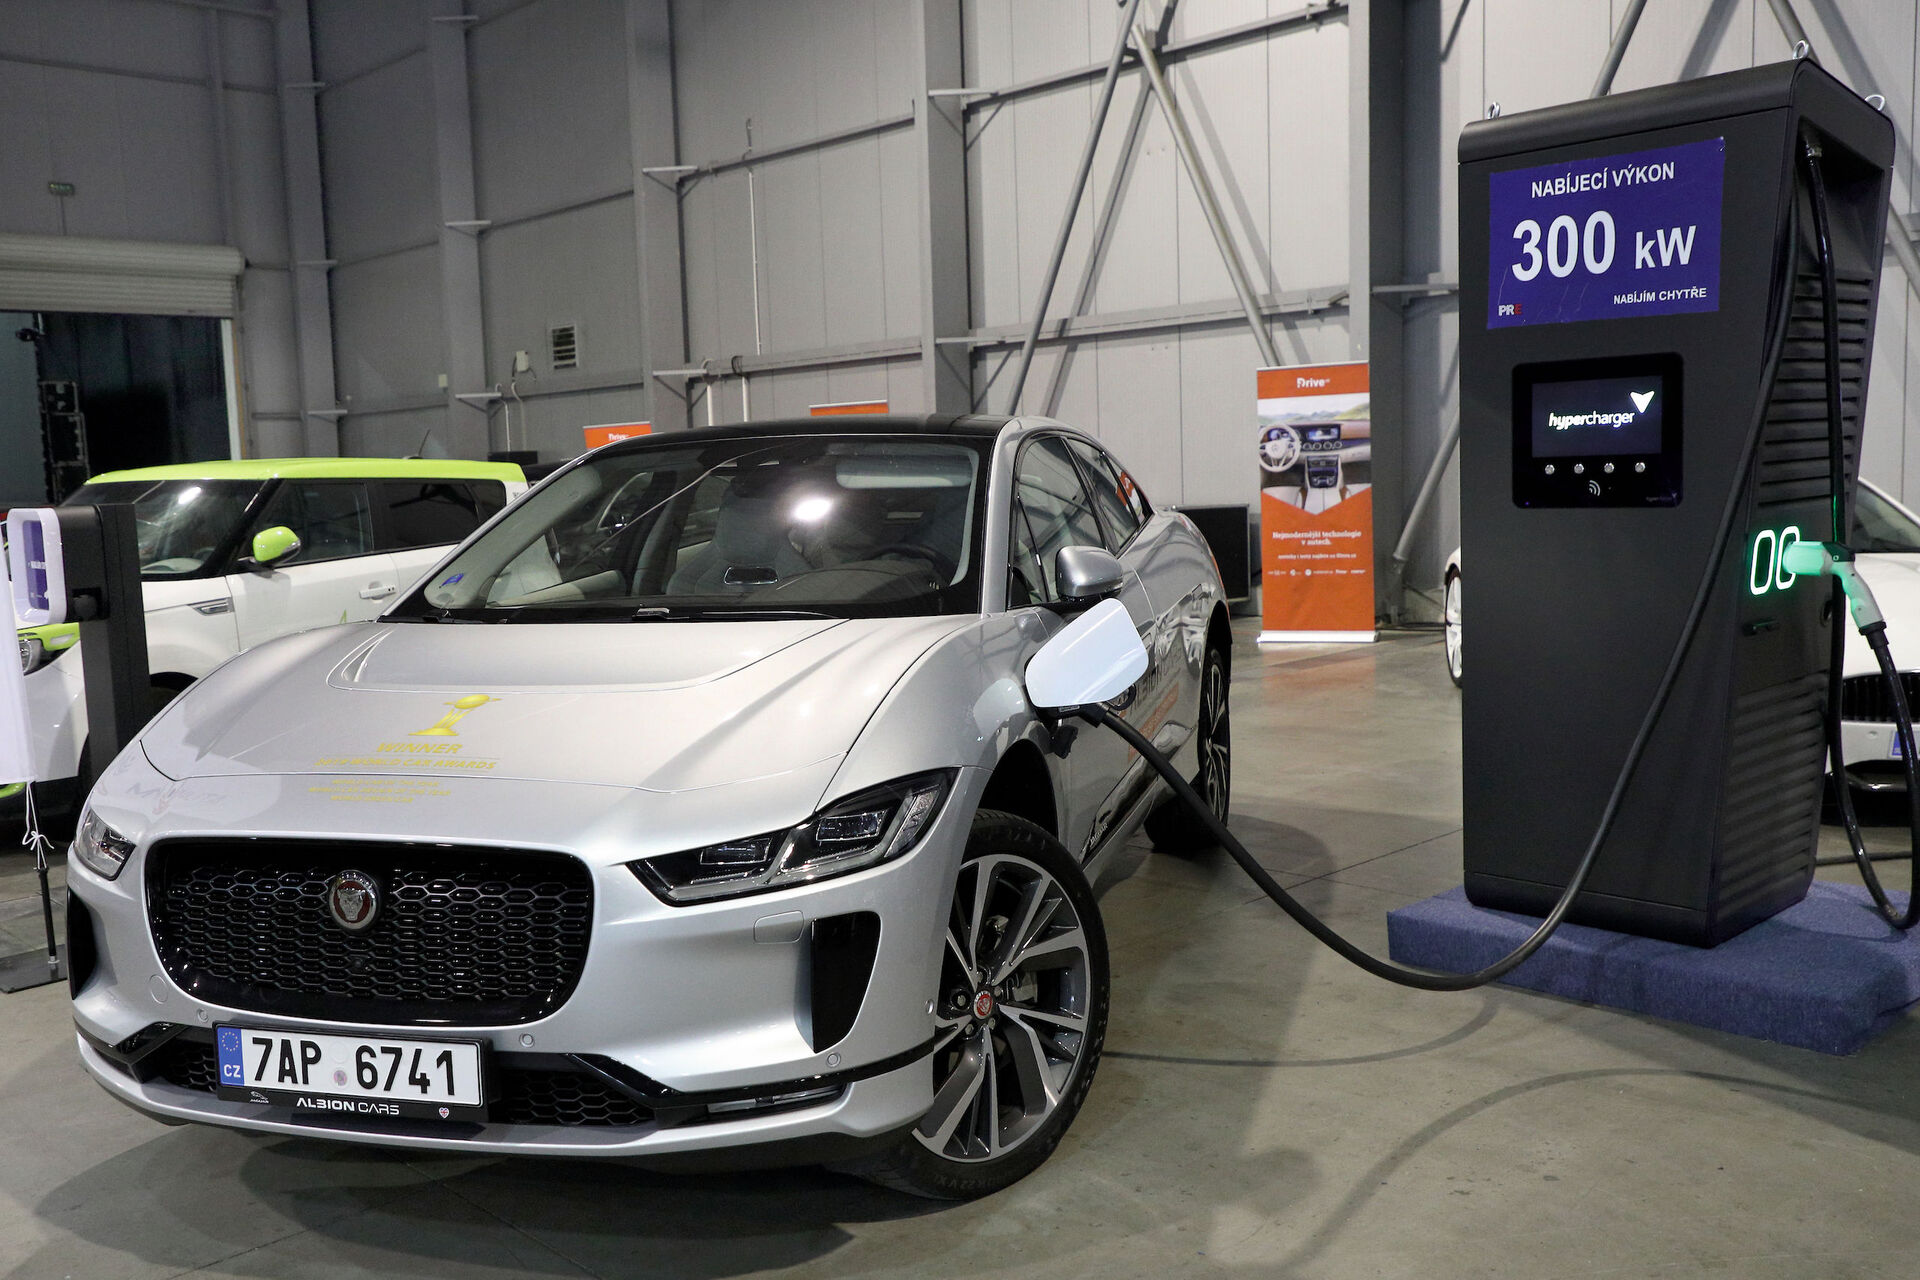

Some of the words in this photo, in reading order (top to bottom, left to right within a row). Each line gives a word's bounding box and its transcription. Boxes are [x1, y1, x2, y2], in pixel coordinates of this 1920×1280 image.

[1531, 167, 1608, 199] NABÍJECÍ
[1612, 161, 1675, 188] VÝKON
[1511, 210, 1616, 282] 300
[1635, 225, 1697, 270] kW
[1613, 289, 1656, 305] NABÍJÍM
[1658, 286, 1707, 301] CHYTŘE
[1498, 303, 1522, 316] PRE
[1548, 410, 1636, 431] hypercharger
[376, 742, 463, 754] WINNER
[433, 759, 497, 769] AWARDS
[223, 1063, 241, 1079] CZ
[252, 1036, 322, 1085] 7AP
[355, 1044, 455, 1096] 6741
[296, 1097, 354, 1113] ALBION
[358, 1099, 399, 1115] CARS
